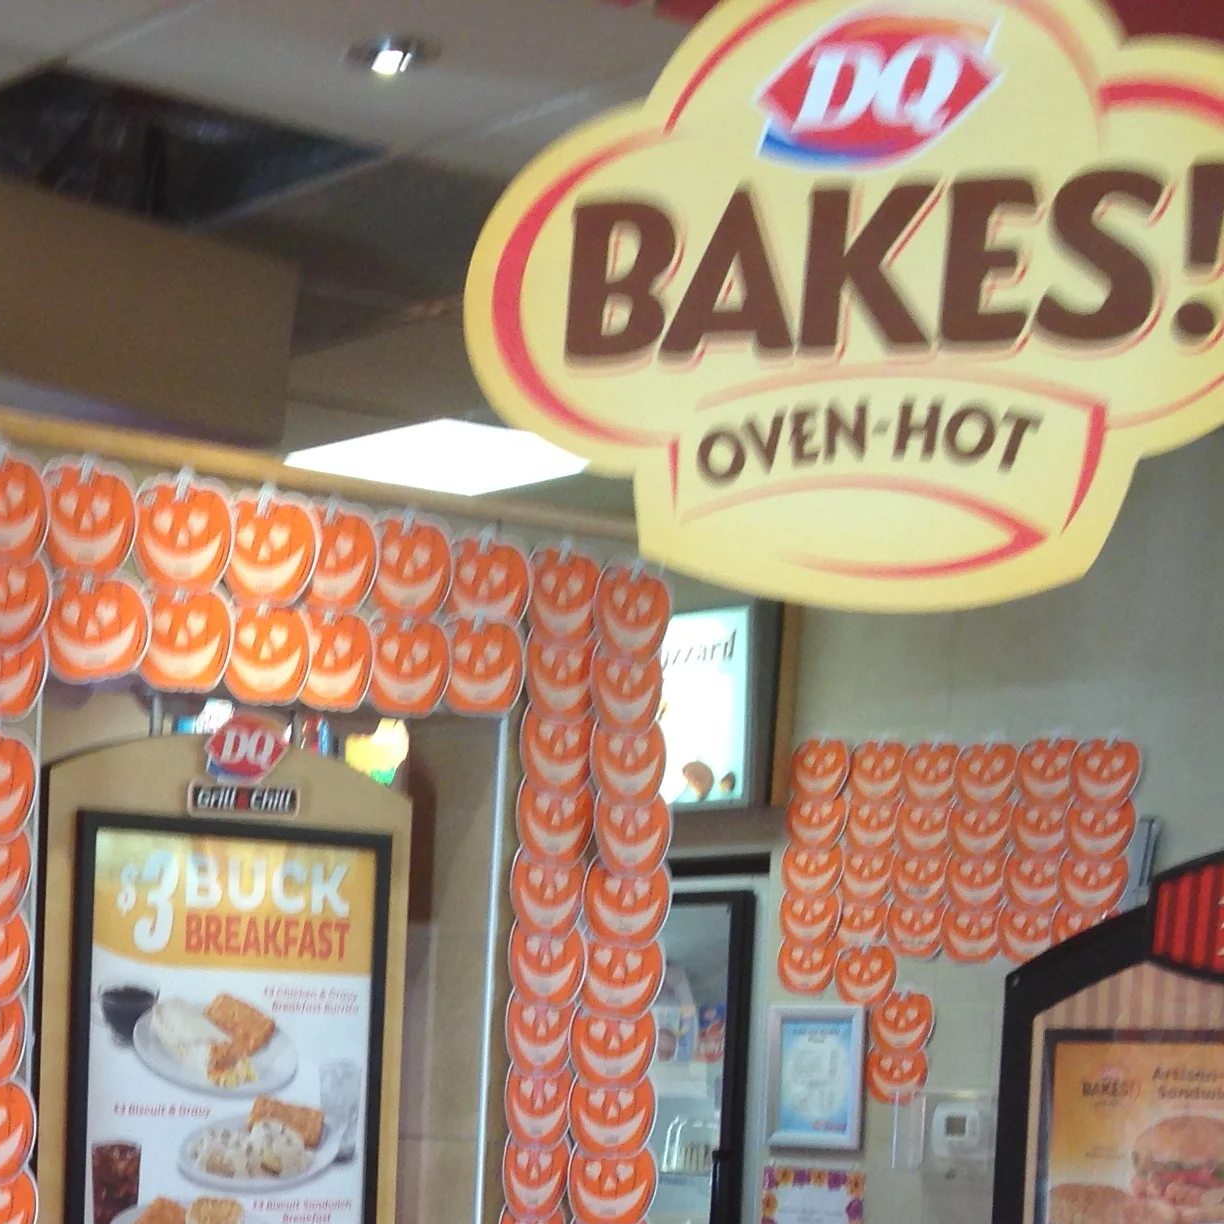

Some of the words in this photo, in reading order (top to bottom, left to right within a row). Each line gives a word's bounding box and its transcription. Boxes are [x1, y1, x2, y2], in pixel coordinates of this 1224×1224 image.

[791, 36, 964, 134] DQ
[564, 163, 1224, 368] BAKES!
[696, 396, 1043, 487] OVEN-HOT
[219, 727, 275, 769] DQ
[116, 847, 180, 954] $3
[184, 856, 350, 918] BUCK
[183, 911, 350, 963] BREAKFAST
